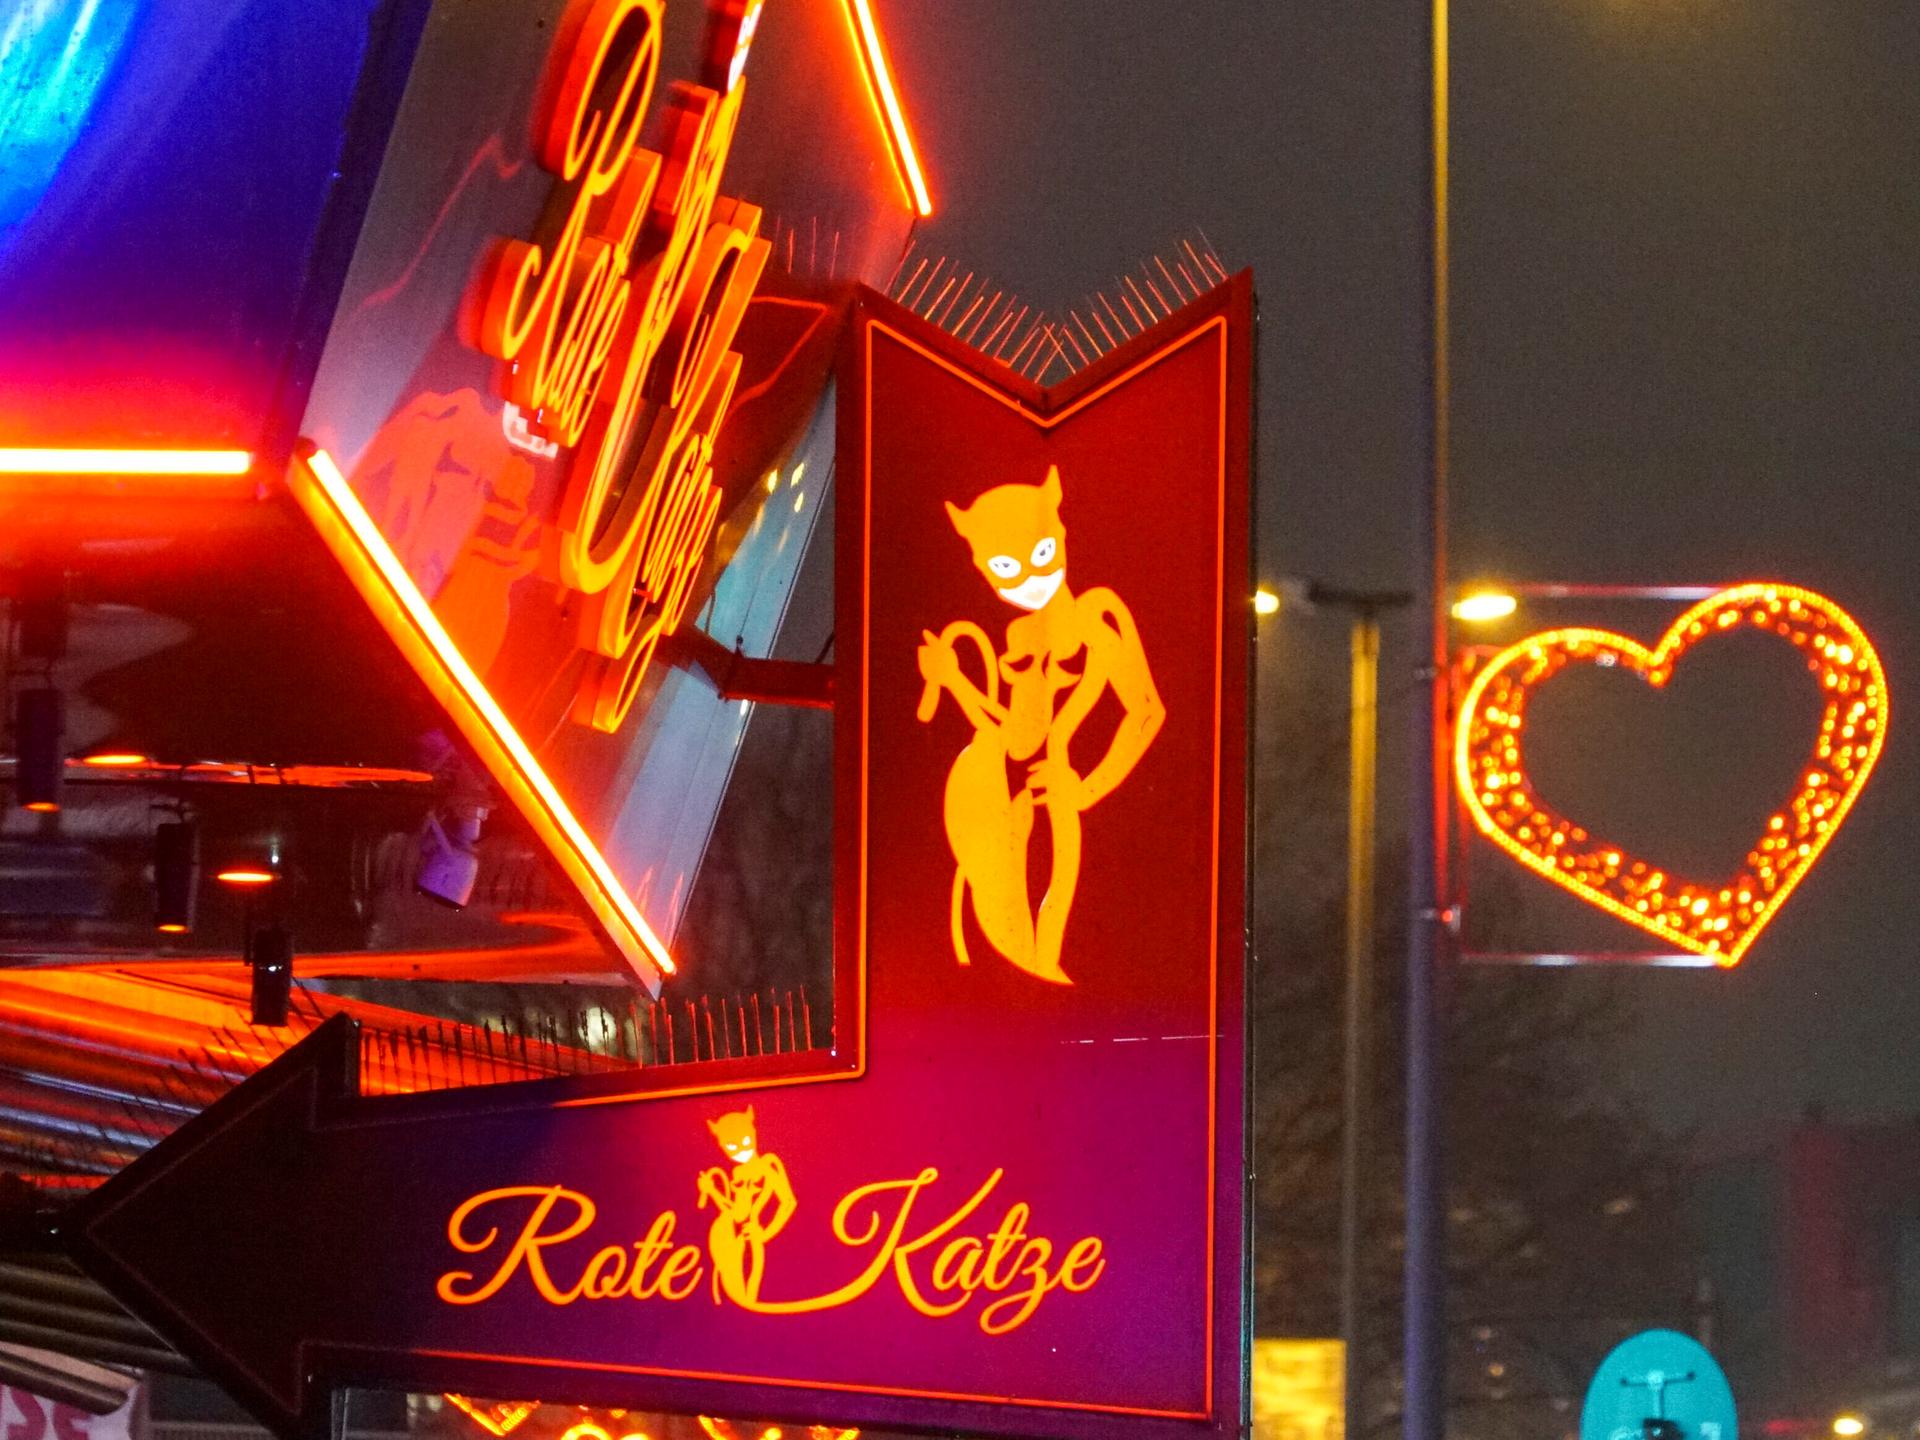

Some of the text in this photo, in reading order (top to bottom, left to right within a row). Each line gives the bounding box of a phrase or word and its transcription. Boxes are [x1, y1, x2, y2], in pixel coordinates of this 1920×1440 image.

[502, 0, 772, 733] Rote Katze
[436, 1167, 1106, 1334] Rote Katze
